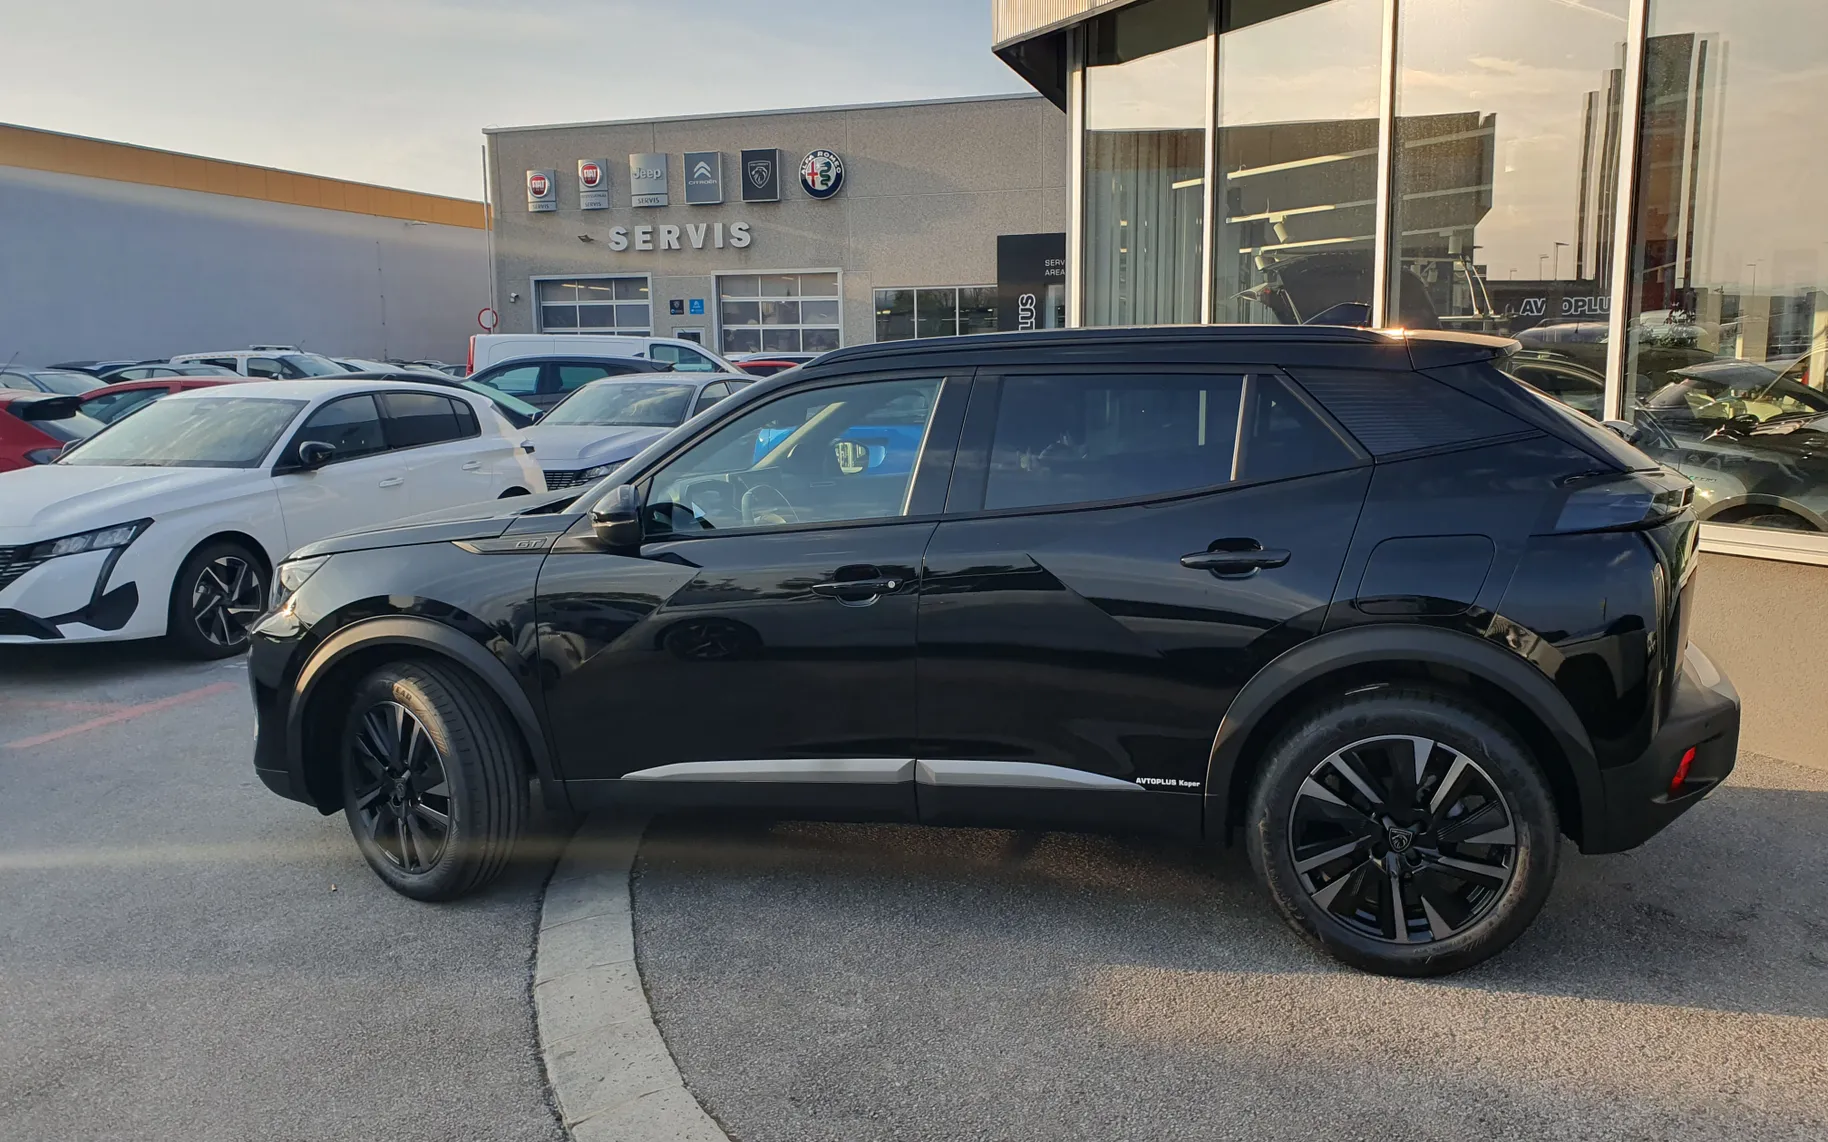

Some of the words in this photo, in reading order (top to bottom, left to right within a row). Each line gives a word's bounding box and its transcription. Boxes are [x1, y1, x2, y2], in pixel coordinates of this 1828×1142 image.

[801, 154, 815, 176] ALFA
[817, 150, 842, 174] ROMEO
[634, 167, 662, 179] Jeep
[608, 221, 751, 252] SERVIS
[1044, 259, 1066, 267] SERV
[1044, 268, 1066, 276] AREA
[1018, 293, 1036, 331] LUS
[515, 540, 541, 549] GT
[1135, 777, 1177, 786] AVTOPLUS
[1179, 779, 1201, 788] Koper
